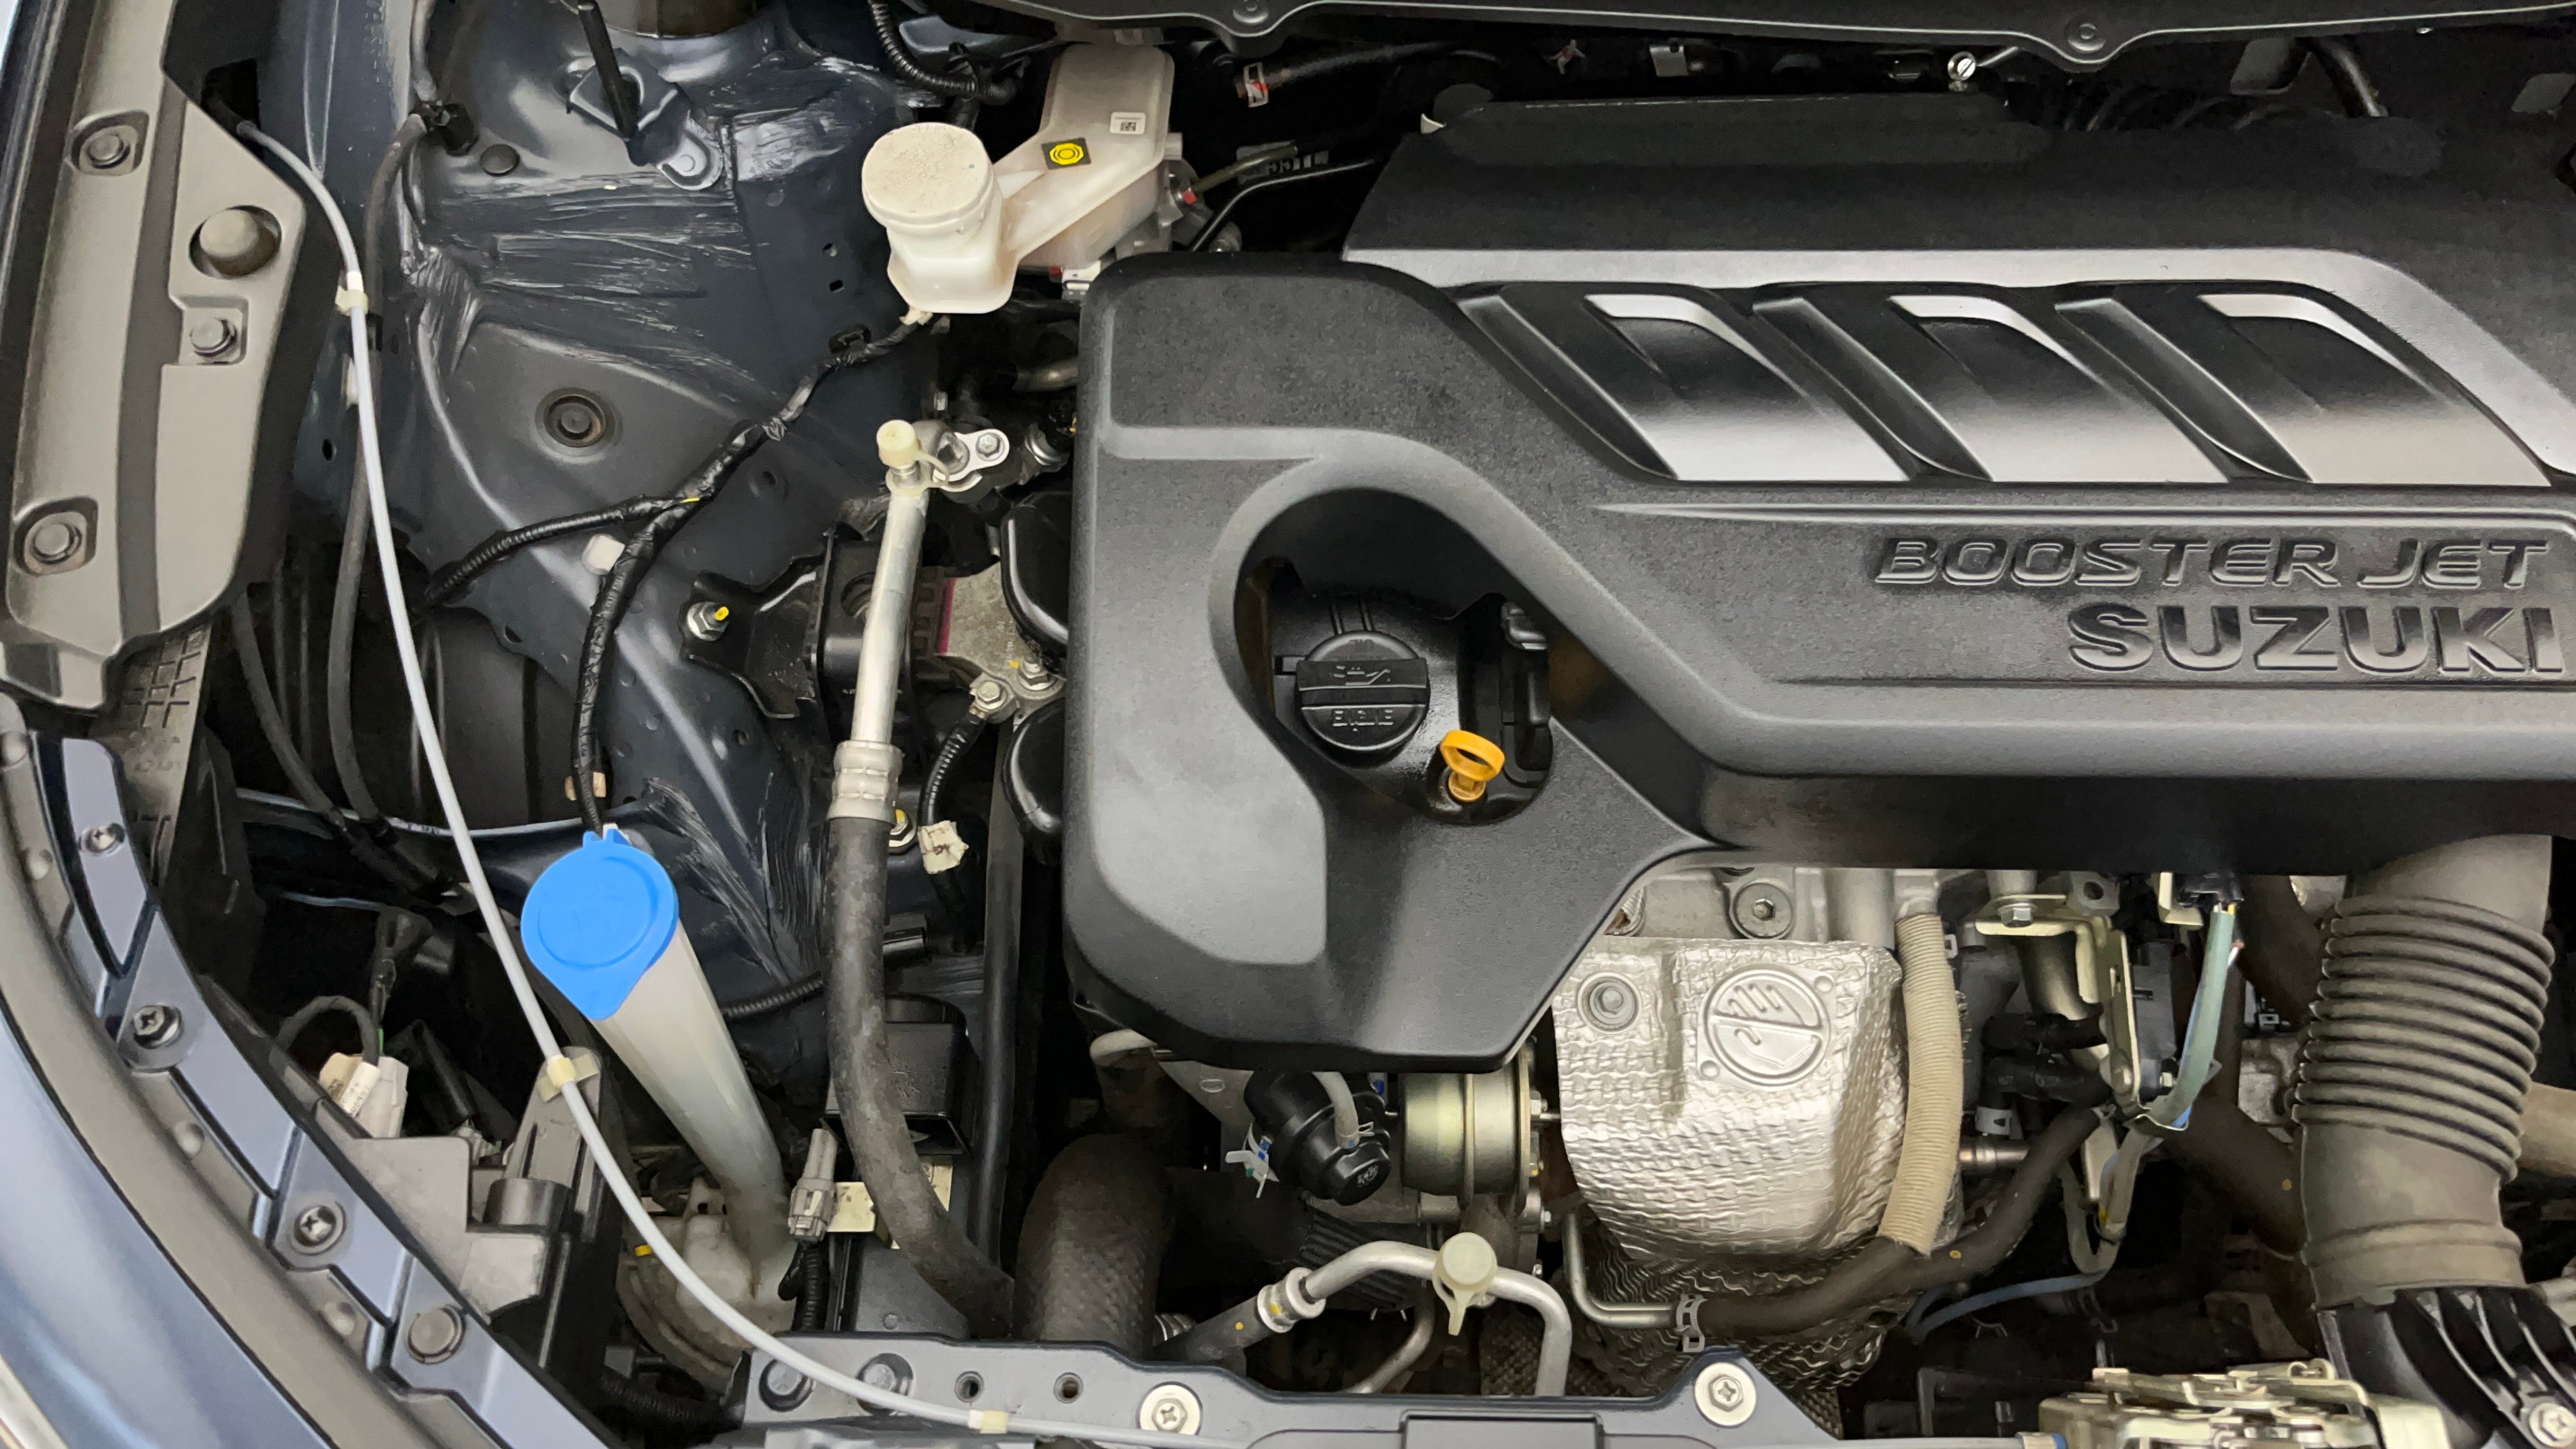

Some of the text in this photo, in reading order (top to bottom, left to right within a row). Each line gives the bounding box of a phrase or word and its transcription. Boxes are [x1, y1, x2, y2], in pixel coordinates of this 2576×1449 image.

[1875, 537, 2550, 590] BOOSTER JET
[2068, 603, 2565, 674] SUZUKI
